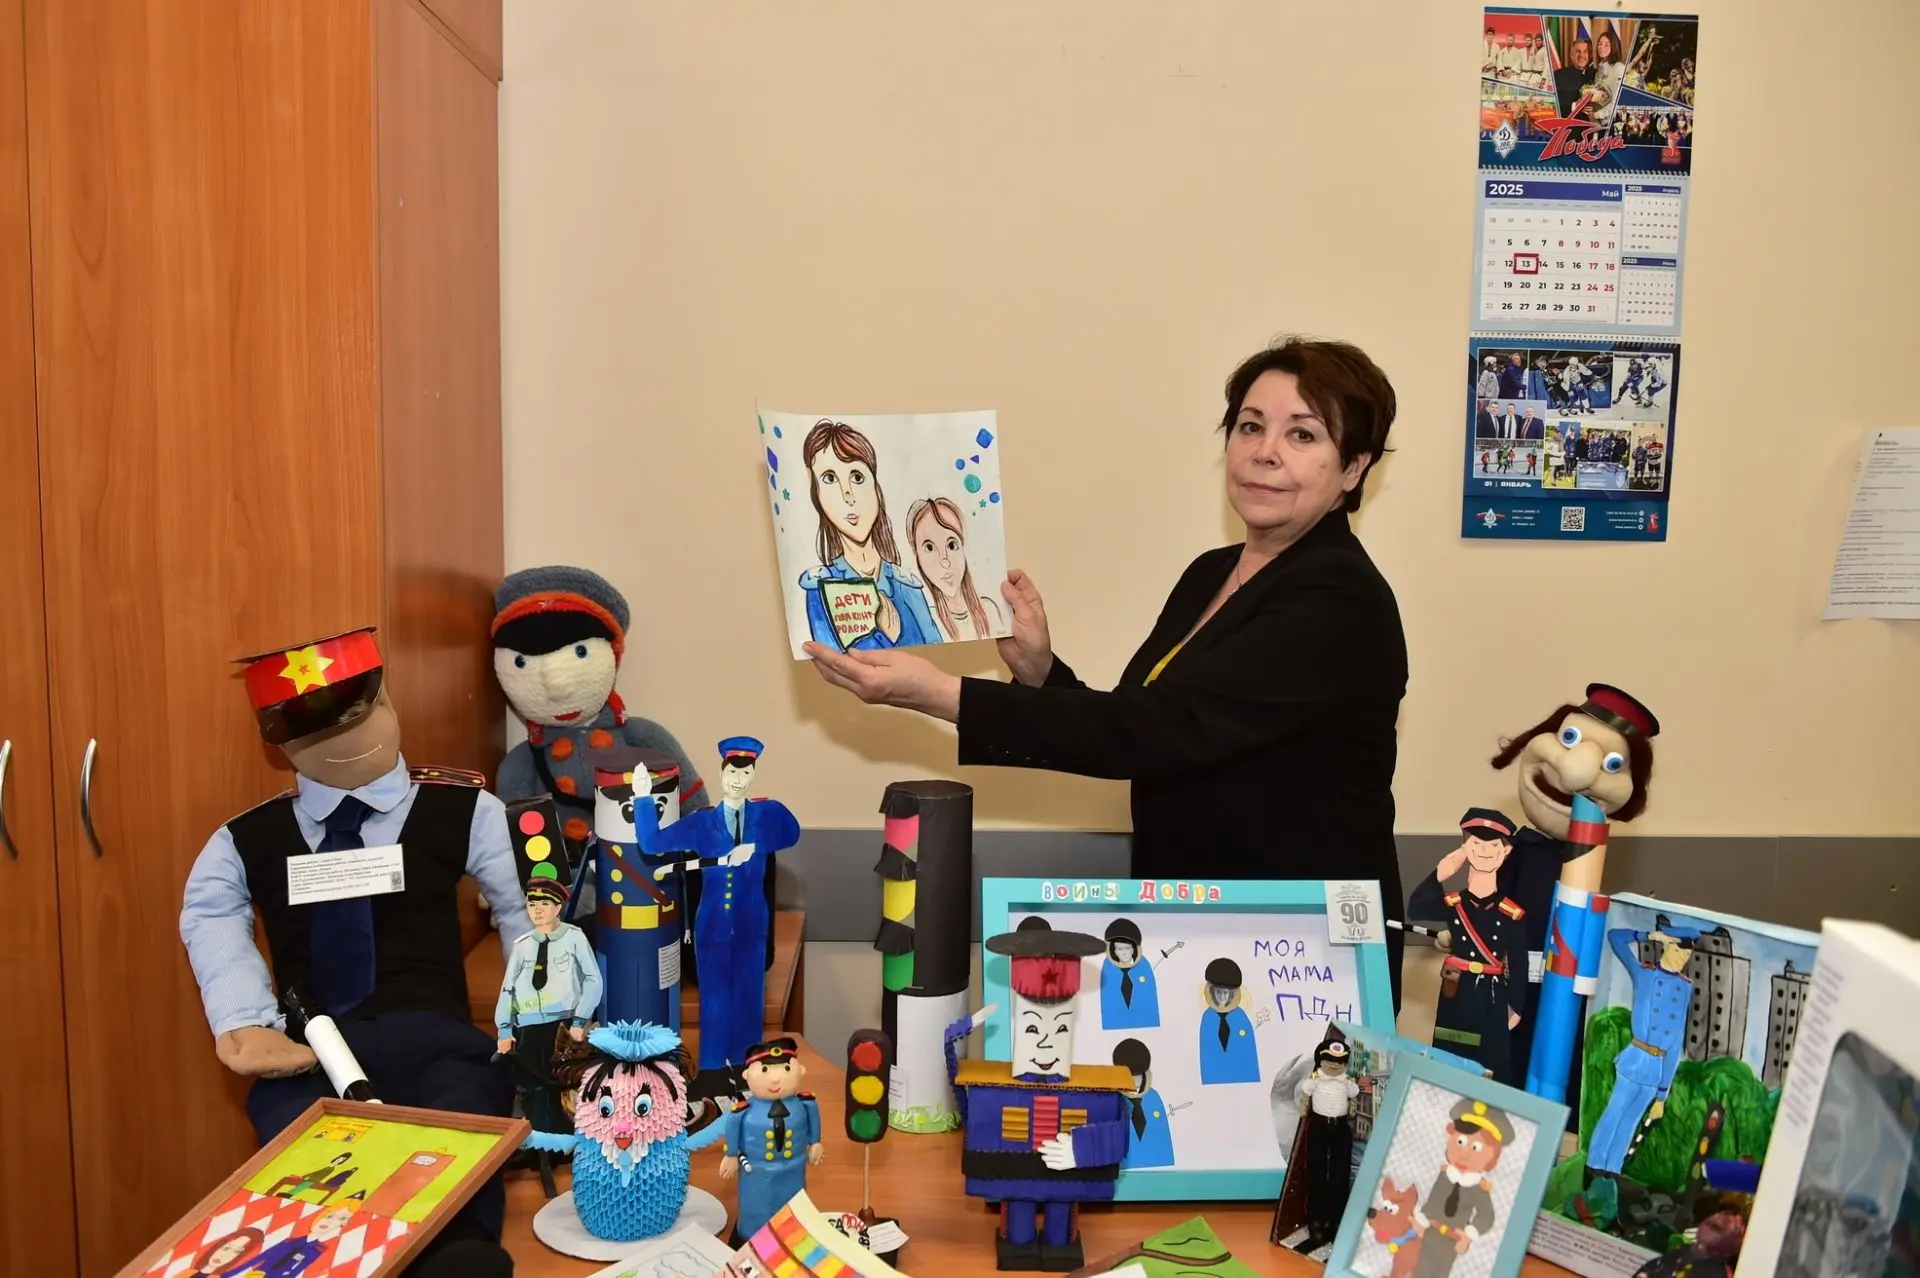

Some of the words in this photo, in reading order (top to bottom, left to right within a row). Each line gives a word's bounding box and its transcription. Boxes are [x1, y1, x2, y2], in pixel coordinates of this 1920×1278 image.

[1534, 93, 1626, 162] Победа
[1489, 184, 1524, 195] 2025
[1139, 880, 1221, 904] Добра
[1340, 902, 1368, 924] 90
[1254, 939, 1305, 958] МОЯ
[1268, 965, 1334, 987] МАМА
[1276, 993, 1352, 1022] ПДН
